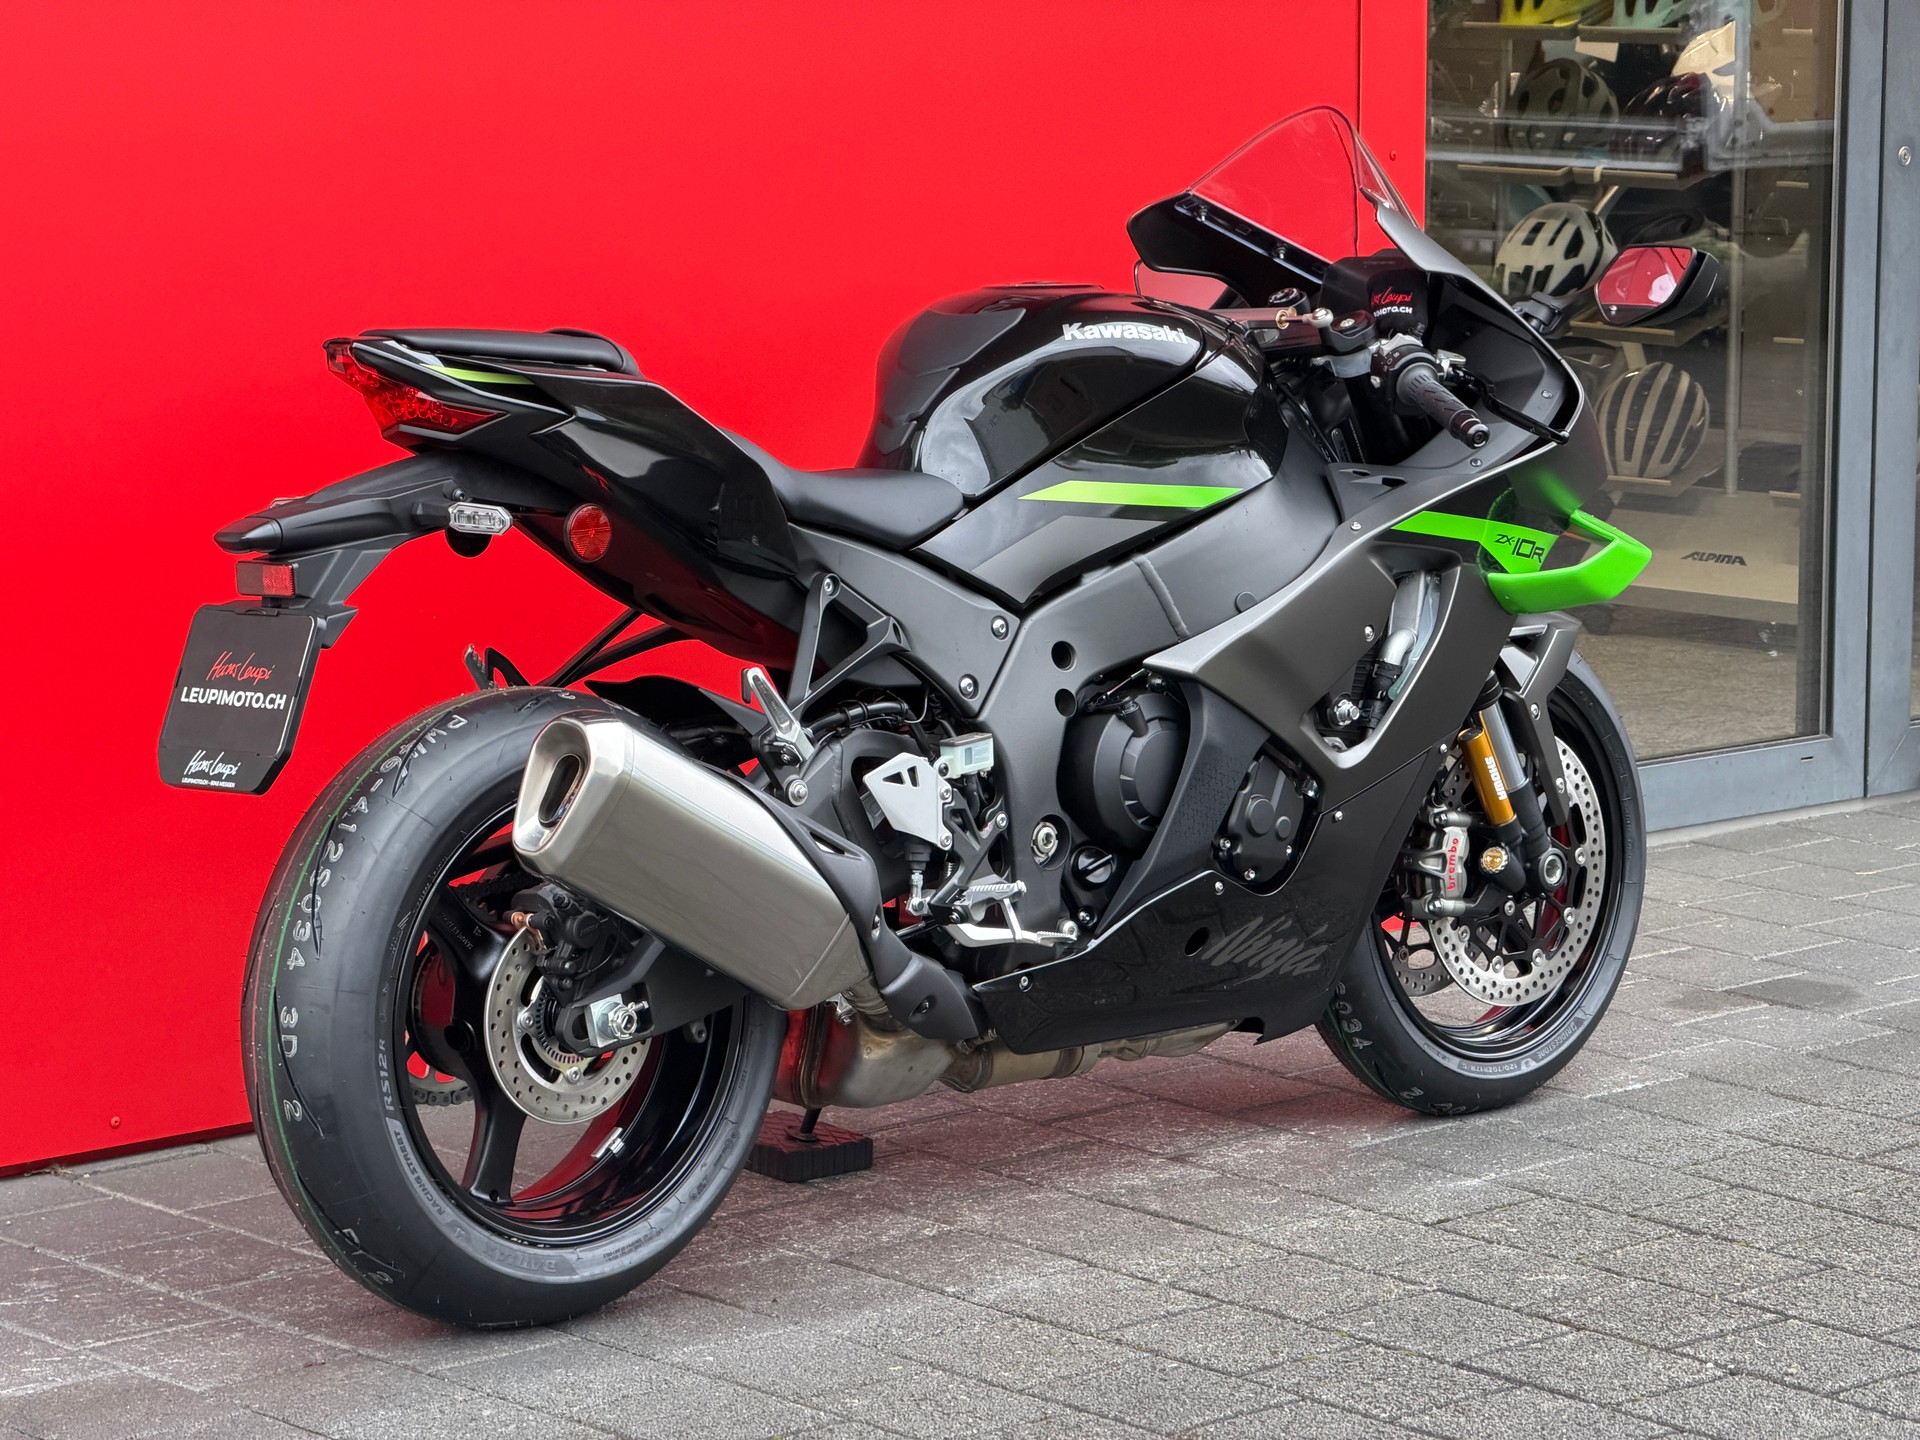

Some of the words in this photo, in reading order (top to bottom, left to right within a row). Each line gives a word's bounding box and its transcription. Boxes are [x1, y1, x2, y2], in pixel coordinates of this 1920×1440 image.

[1062, 322, 1188, 344] Kawasaki
[1494, 533, 1545, 564] ZX-10R
[1680, 551, 1747, 567] ALPINA
[206, 651, 242, 681] Hans
[237, 653, 275, 686] Leupi
[180, 687, 287, 710] LEUPIMOTO.CH
[184, 750, 213, 776] Hans
[209, 751, 241, 780] Leupi
[1485, 755, 1508, 801] SHOWA
[1447, 838, 1459, 891] brembo
[1201, 916, 1329, 986] Ninja
[1536, 1021, 1579, 1059] BRIDGESTONE
